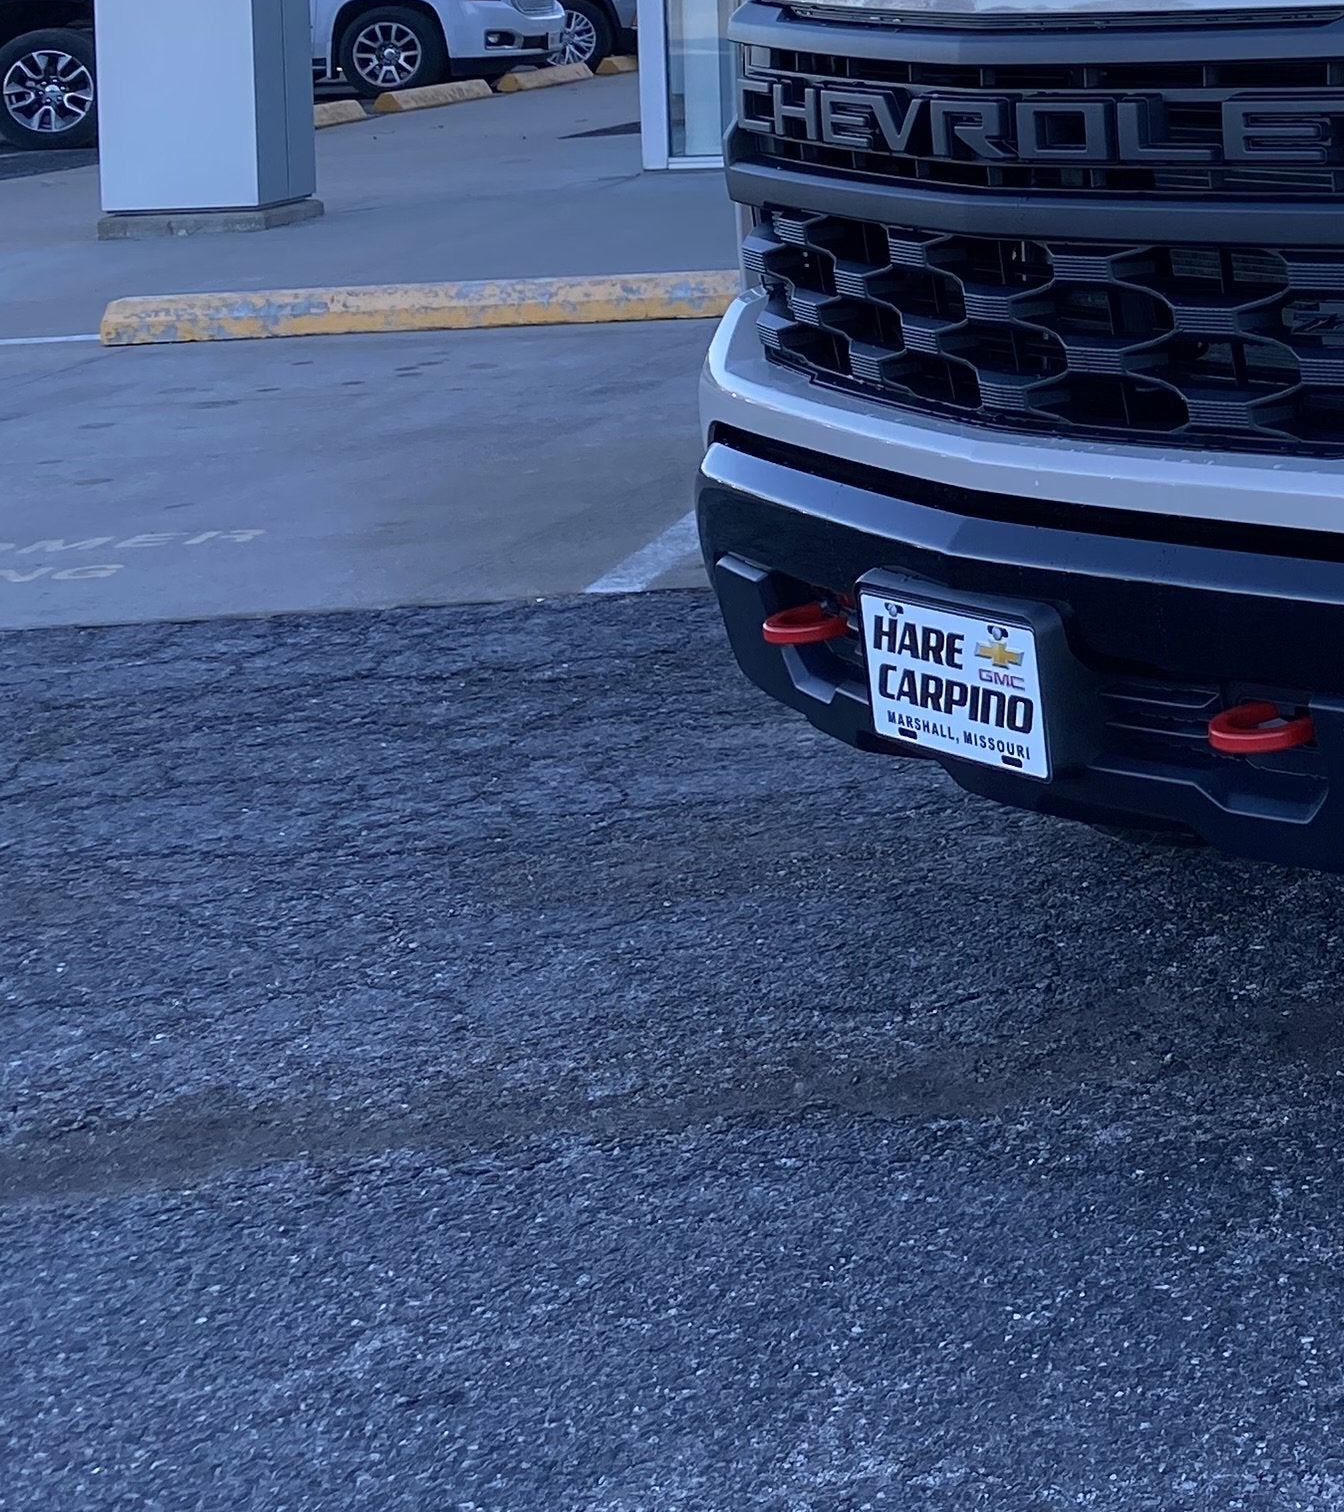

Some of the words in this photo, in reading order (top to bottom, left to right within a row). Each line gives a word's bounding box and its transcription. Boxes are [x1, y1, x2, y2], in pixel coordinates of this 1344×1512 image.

[873, 614, 965, 670] HARE
[878, 662, 1034, 735] CARPINO
[978, 668, 1026, 692] GMC
[887, 709, 960, 745] MARSHALL,
[963, 730, 1031, 760] MISSOURI
